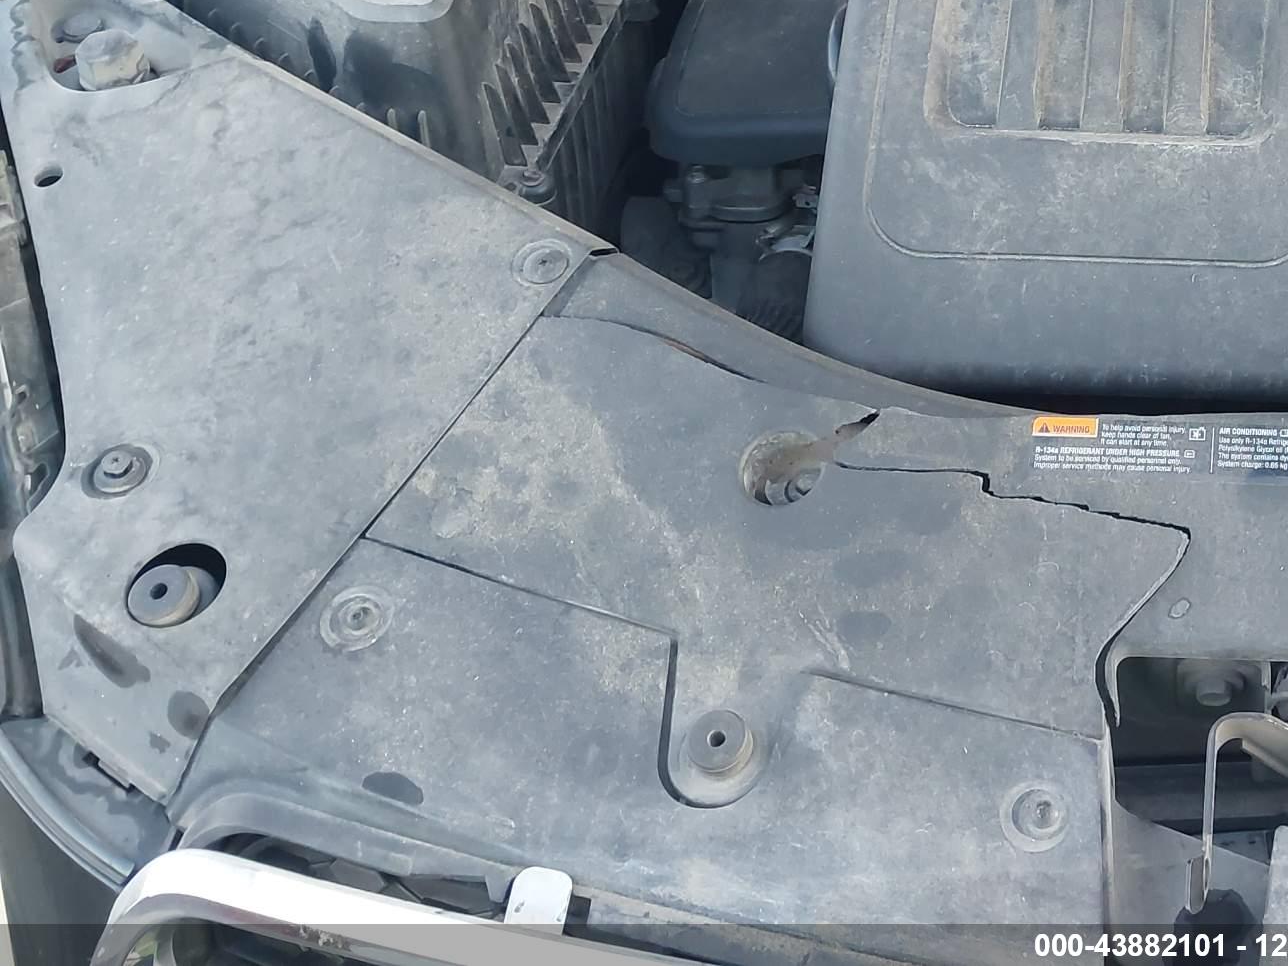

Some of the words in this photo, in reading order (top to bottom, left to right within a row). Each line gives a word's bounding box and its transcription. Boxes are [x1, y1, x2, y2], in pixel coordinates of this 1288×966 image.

[1053, 425, 1090, 434] WARNING
[1110, 424, 1123, 432] help
[1142, 425, 1168, 434] personal
[1219, 427, 1231, 435] AIR
[1232, 428, 1278, 436] CONDITIONING
[1231, 437, 1244, 445] only
[1035, 446, 1059, 454] R-134a
[1060, 446, 1104, 455] REFRIGERANT
[1146, 449, 1180, 457] PRESSURE
[1218, 445, 1255, 453] Polyalkylene
[1256, 445, 1275, 454] Glycol
[1034, 454, 1057, 462] System
[1074, 455, 1100, 463] serviced
[1101, 456, 1109, 464] by
[1110, 456, 1136, 465] qualified
[1137, 457, 1167, 465] personnel
[1033, 461, 1060, 470] Improper
[1062, 462, 1084, 470] service
[1112, 464, 1126, 472] may
[1217, 460, 1240, 468] System
[1280, 462, 1288, 471] kg
